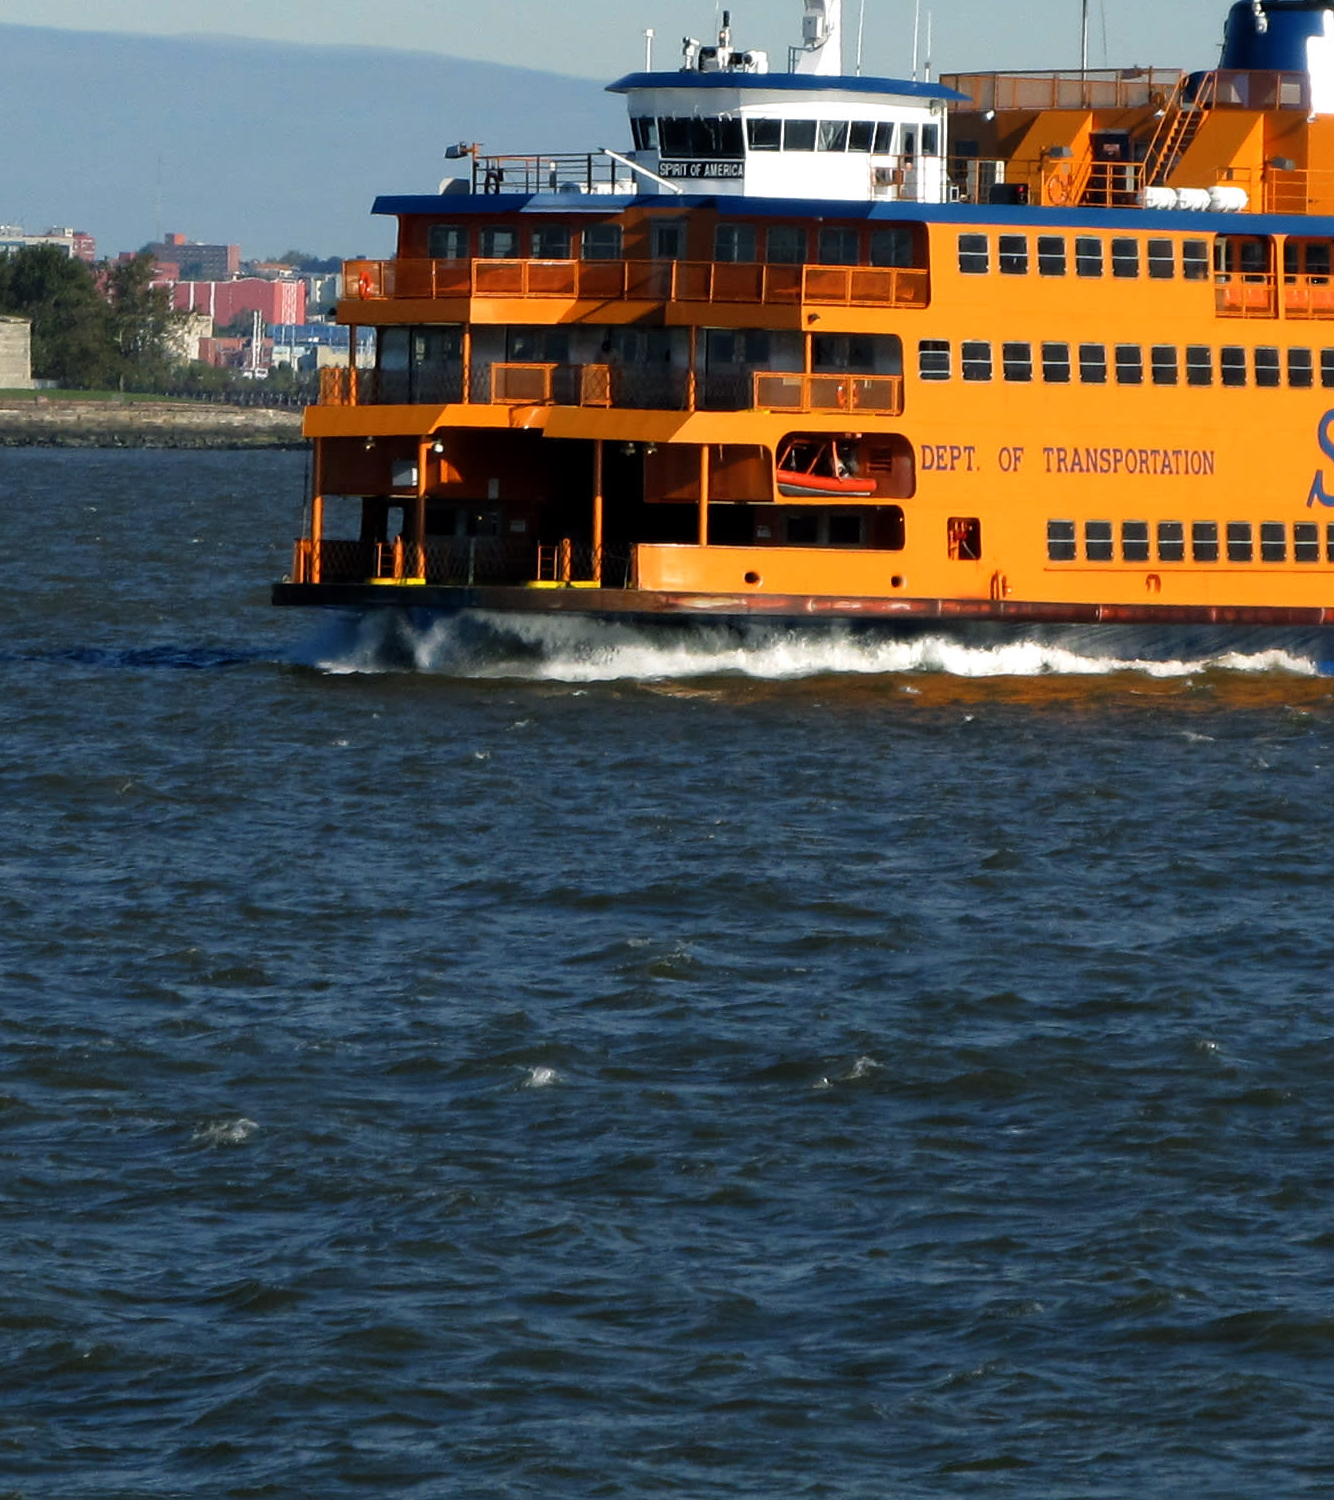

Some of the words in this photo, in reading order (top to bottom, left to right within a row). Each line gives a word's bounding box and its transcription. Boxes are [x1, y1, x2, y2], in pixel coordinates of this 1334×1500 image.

[660, 163, 688, 176] SPIRIT
[690, 164, 703, 176] OF
[704, 164, 743, 177] AMERICA
[921, 445, 980, 471] DEPT.
[999, 447, 1024, 472] OF
[1043, 447, 1215, 475] TRANSPORTATION
